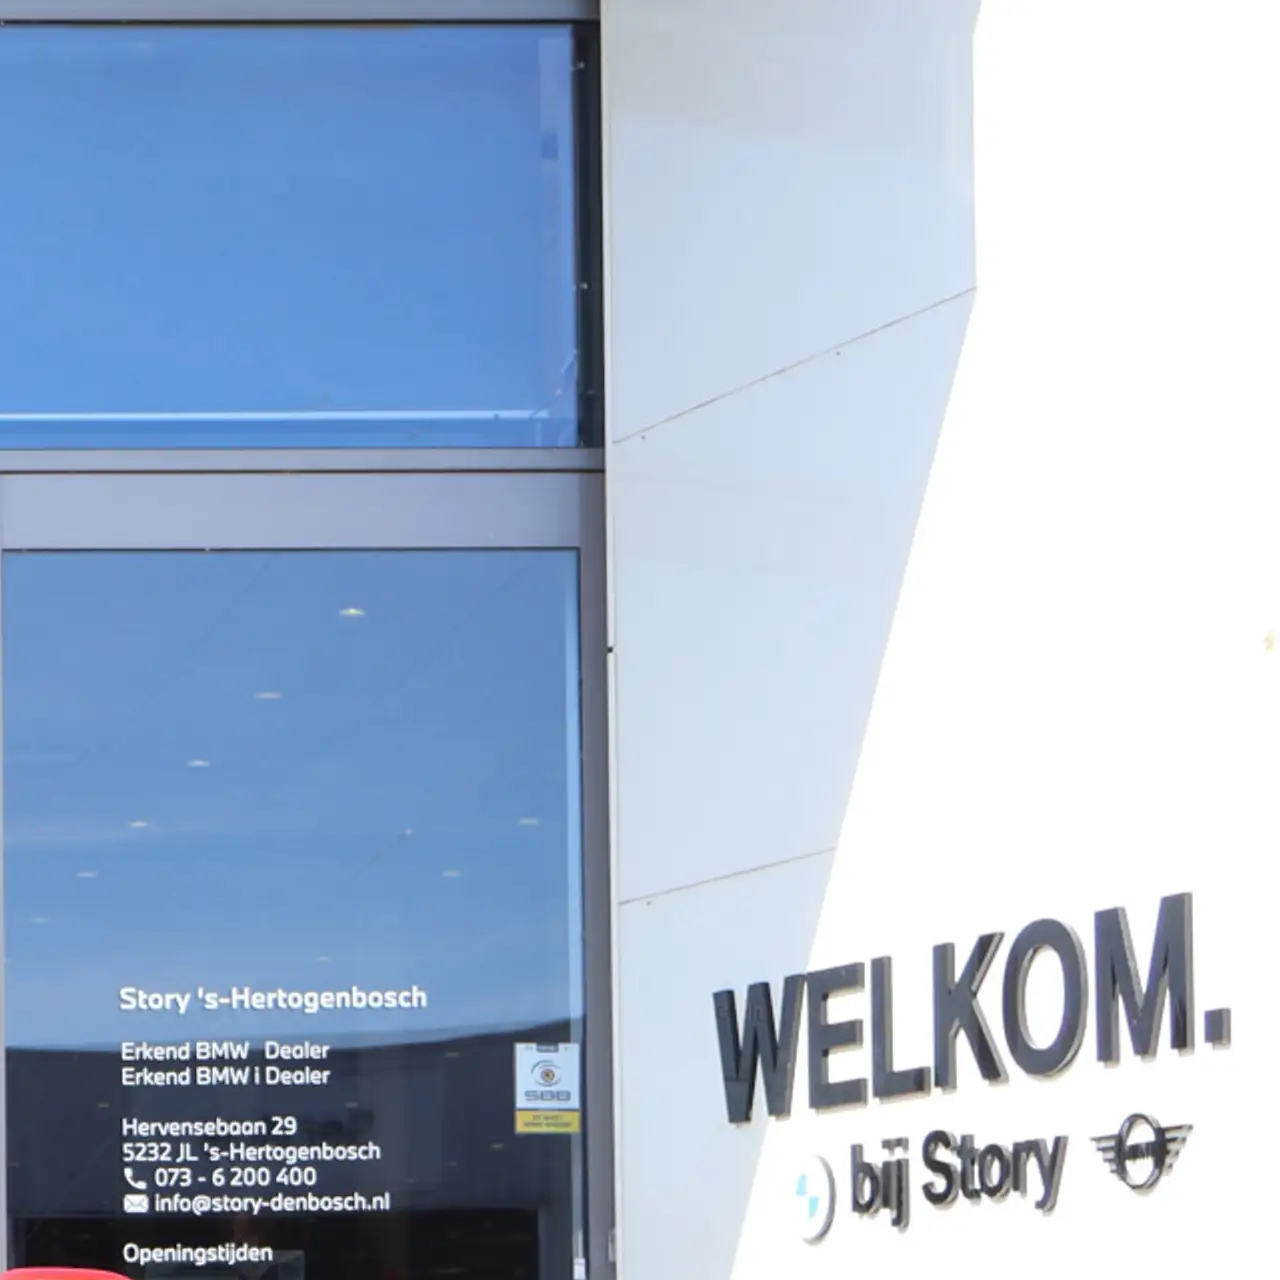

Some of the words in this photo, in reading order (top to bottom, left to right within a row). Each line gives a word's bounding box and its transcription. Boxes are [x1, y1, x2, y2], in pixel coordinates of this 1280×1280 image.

[120, 987, 190, 1013] Story
[198, 986, 427, 1013] 's-Hertogenbosch
[712, 892, 1231, 1128] WELKOM.
[122, 1042, 190, 1061] Erkend
[196, 1042, 249, 1059] BMW
[265, 1041, 329, 1059] Dealer
[122, 1067, 190, 1085] Erkend
[197, 1067, 249, 1085] BMW
[255, 1067, 259, 1084] i
[266, 1066, 330, 1084] Dealer
[123, 1118, 266, 1136] Hervensebaan
[272, 1116, 297, 1135] 29
[123, 1142, 171, 1161] 5232
[176, 1143, 198, 1162] JL
[204, 1142, 381, 1166] 's-Hertogenbosch
[155, 1168, 191, 1186] 073
[212, 1168, 225, 1186] 6
[231, 1167, 270, 1186] 200
[276, 1167, 316, 1185] 400
[850, 1137, 909, 1230] bij
[922, 1130, 1068, 1213] Story
[156, 1192, 389, 1215] info@story-denbosch.nl
[123, 1243, 273, 1265] Openingstijden
